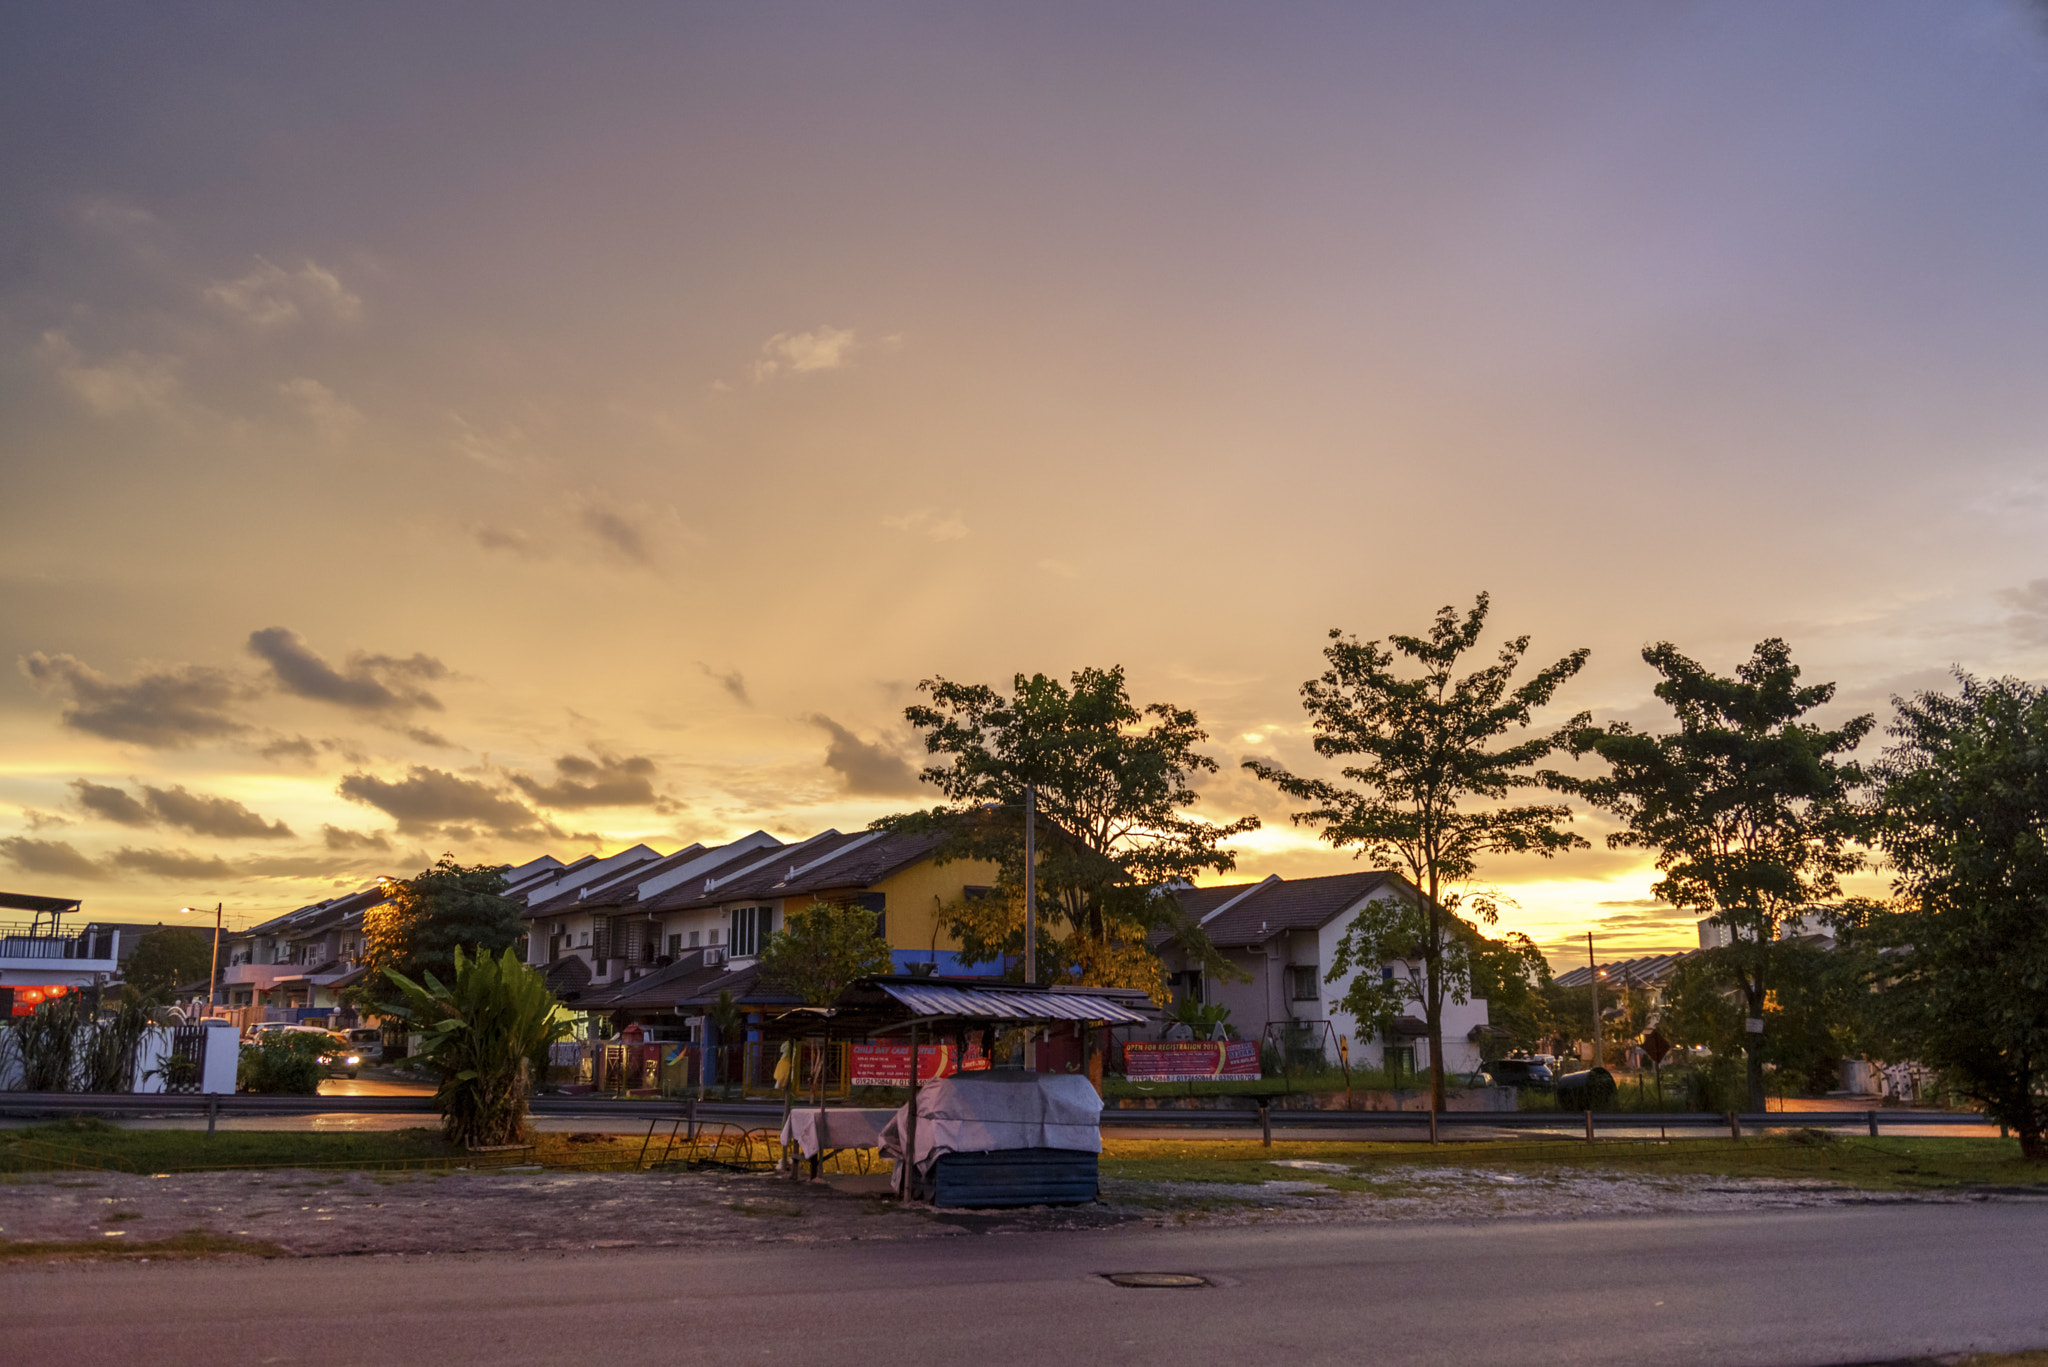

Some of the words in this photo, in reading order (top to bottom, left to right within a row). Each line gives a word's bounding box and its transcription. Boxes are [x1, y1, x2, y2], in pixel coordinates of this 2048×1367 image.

[853, 1046, 874, 1054] CHILD
[875, 1046, 889, 1055] DAY
[891, 1047, 909, 1055] CARE
[1158, 1043, 1201, 1051] REGISTRATION
